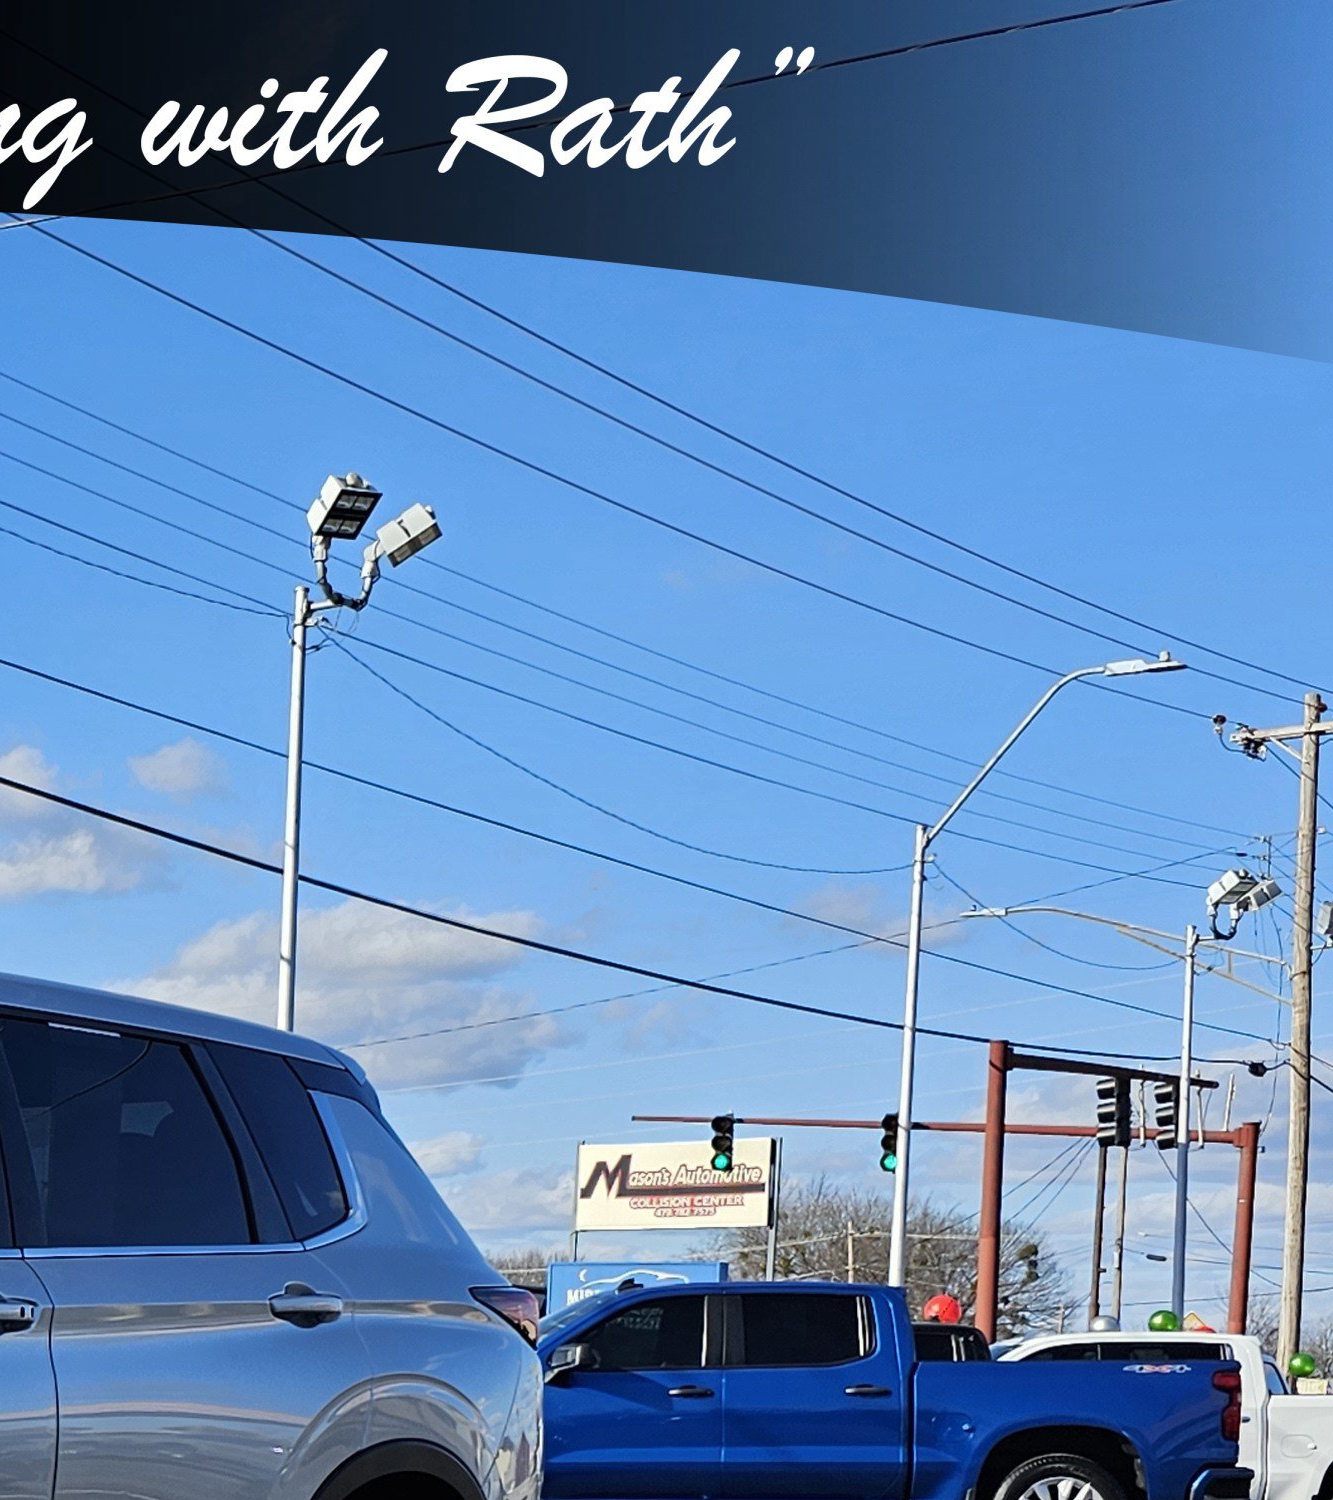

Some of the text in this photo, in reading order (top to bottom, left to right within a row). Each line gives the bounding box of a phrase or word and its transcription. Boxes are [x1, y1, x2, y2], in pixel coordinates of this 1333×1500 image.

[580, 1154, 763, 1199] Mason's Automotive
[629, 1194, 745, 1209] COLLISION CENTER
